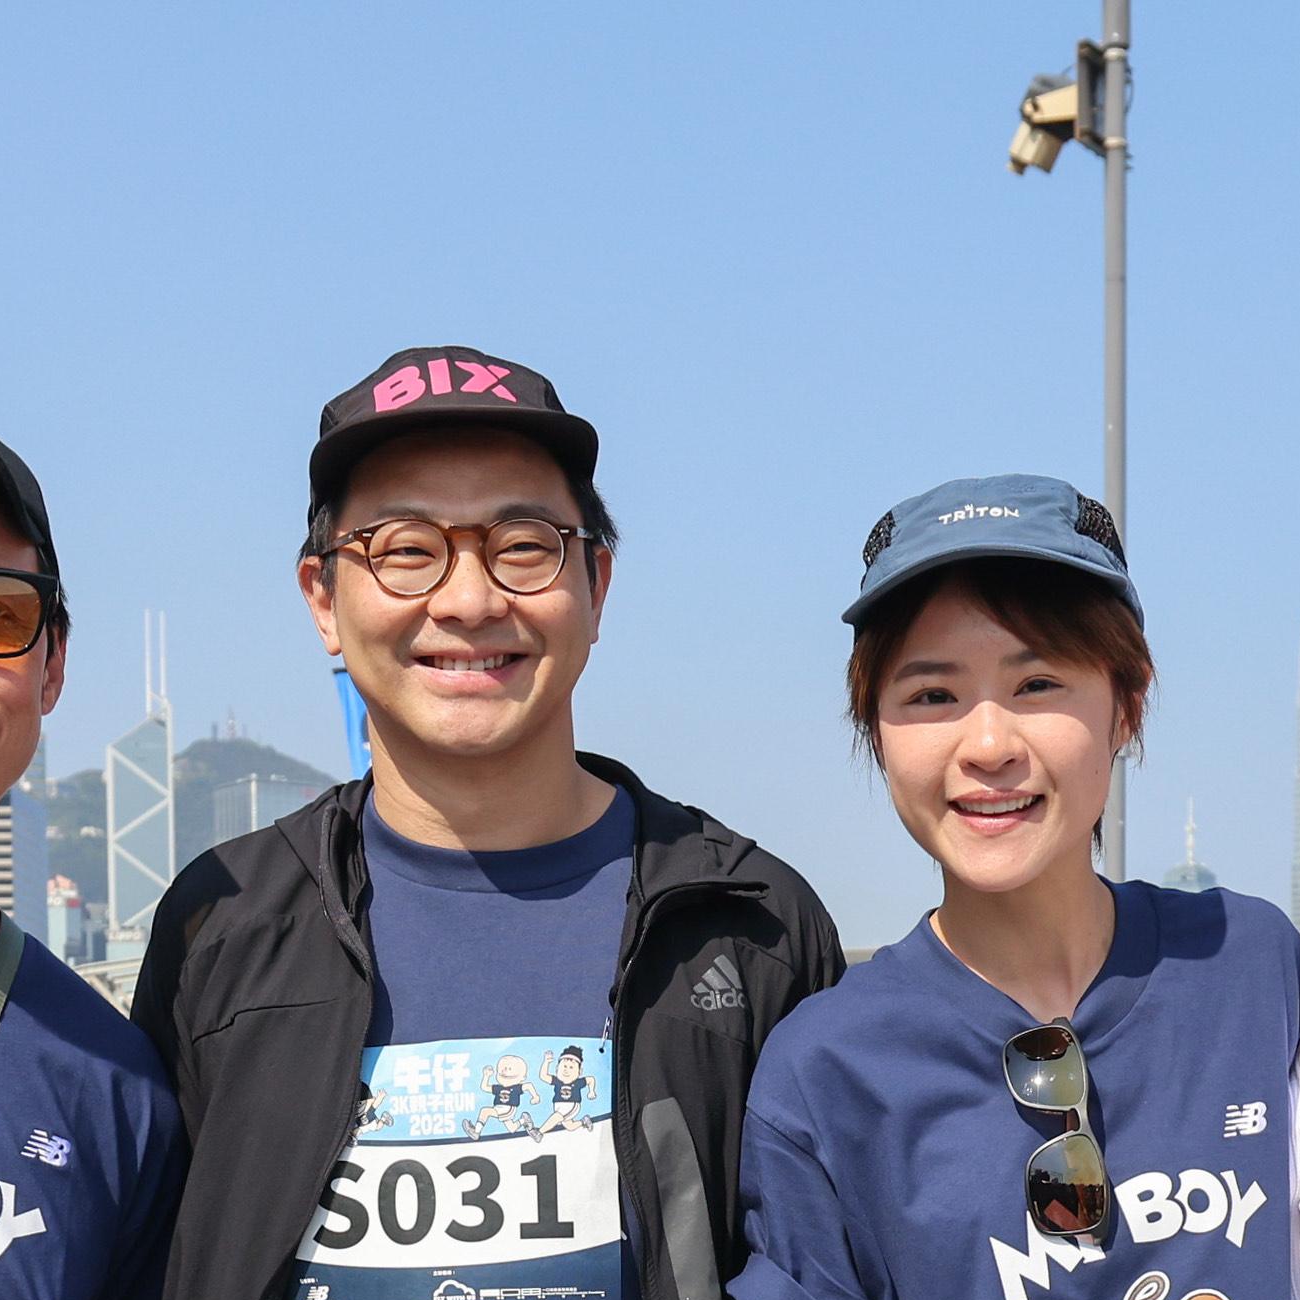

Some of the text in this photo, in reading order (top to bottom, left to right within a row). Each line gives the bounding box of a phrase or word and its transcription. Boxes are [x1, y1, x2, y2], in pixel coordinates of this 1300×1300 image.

[372, 357, 518, 414] BIX
[394, 1053, 470, 1094] 牛仔
[410, 1112, 456, 1137] 2025
[312, 1154, 574, 1249] S031
[1113, 1168, 1268, 1249] BOY
